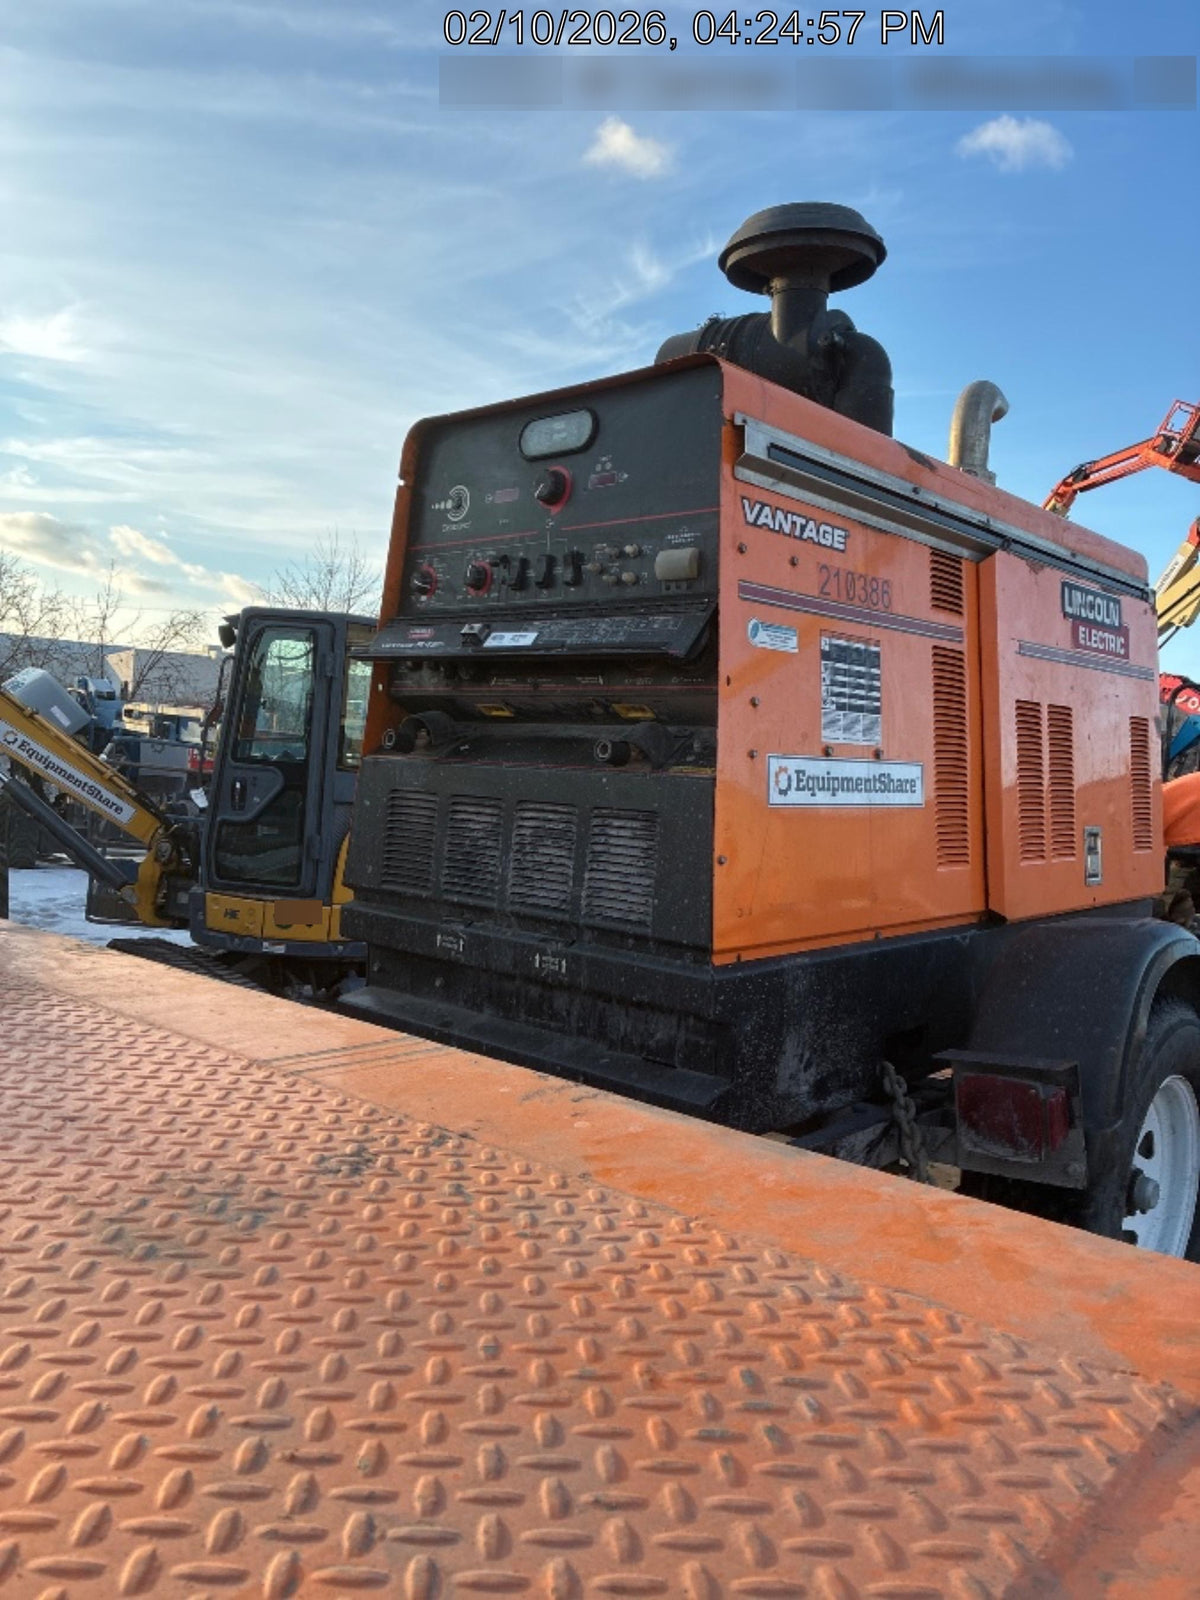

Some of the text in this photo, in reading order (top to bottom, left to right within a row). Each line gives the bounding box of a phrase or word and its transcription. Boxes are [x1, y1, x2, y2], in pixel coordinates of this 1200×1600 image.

[742, 497, 847, 552] VANTAGE
[818, 563, 893, 610] 210386
[1063, 585, 1121, 628] LINCOLN
[1078, 625, 1126, 656] ELECTRIC
[17, 739, 124, 816] EquipmentShare
[794, 769, 917, 797] EquipmentShare
